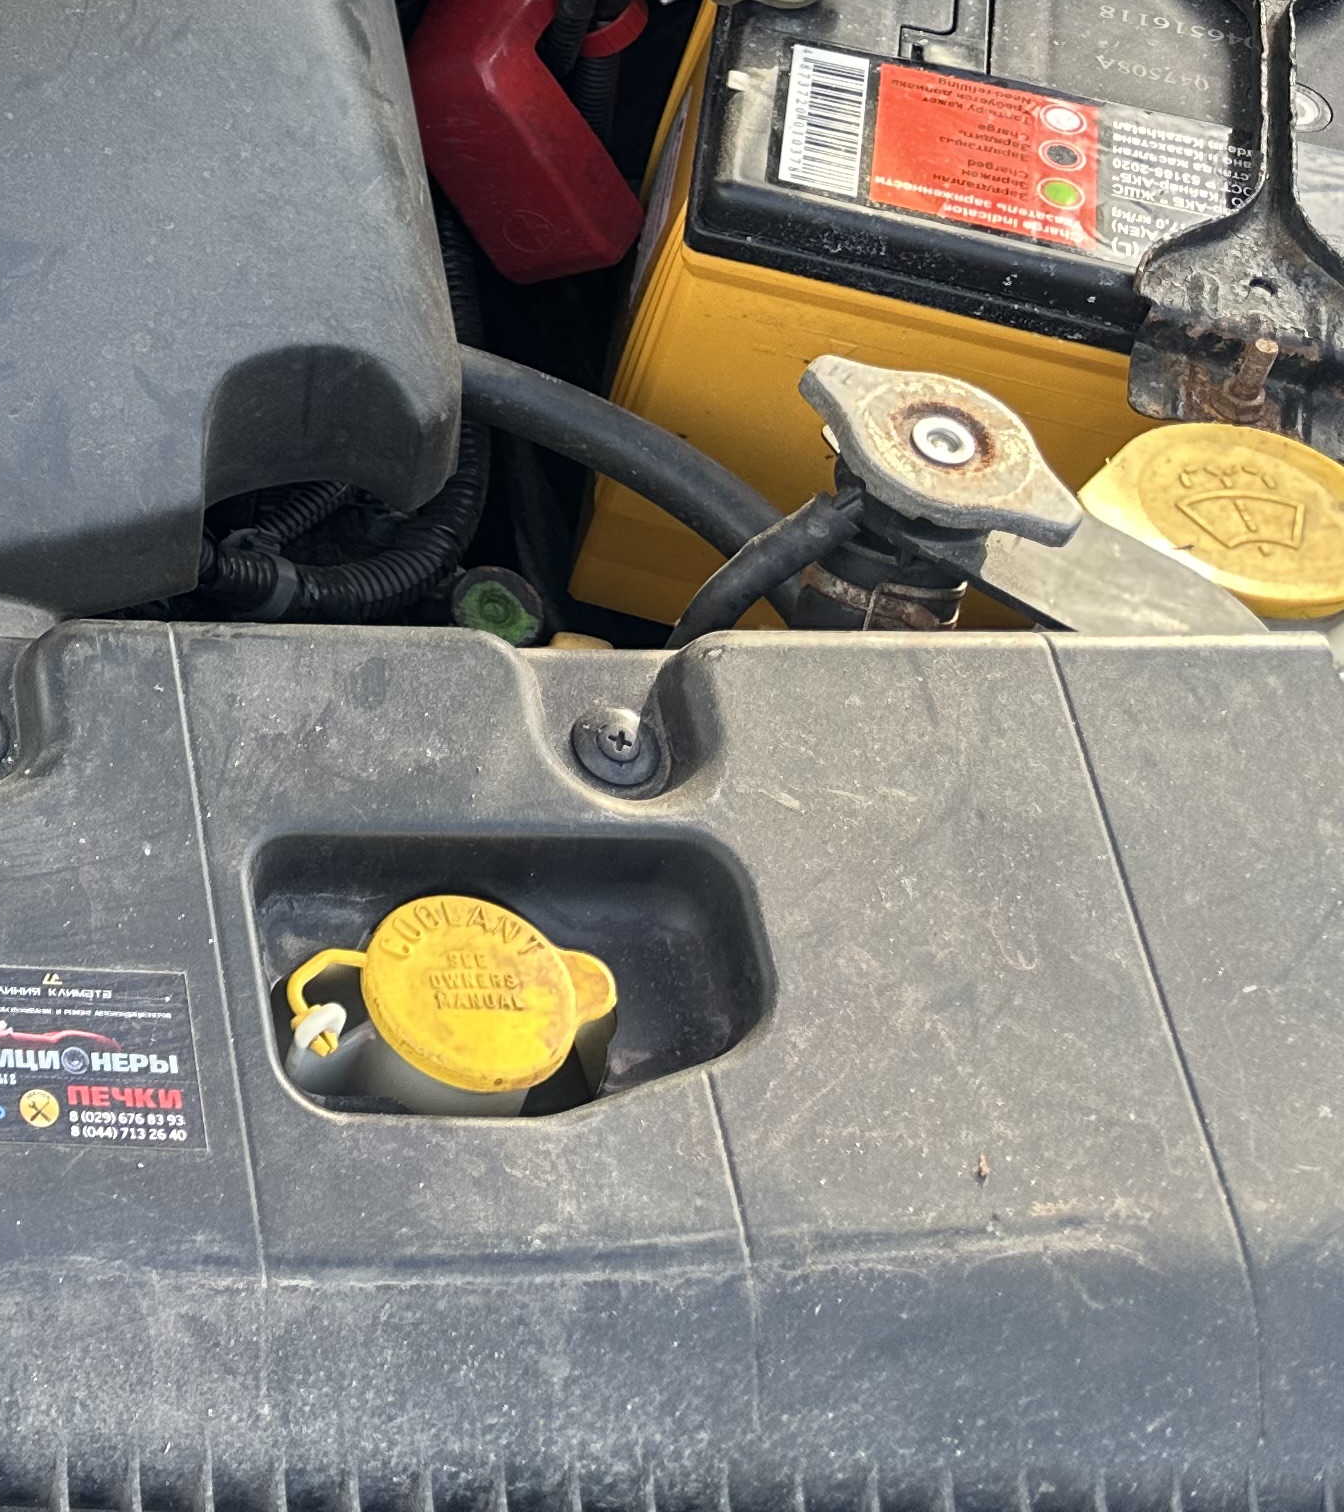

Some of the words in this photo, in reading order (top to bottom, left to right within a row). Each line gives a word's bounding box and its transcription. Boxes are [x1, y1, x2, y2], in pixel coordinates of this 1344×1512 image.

[995, 91, 1032, 105] Need
[977, 123, 1030, 141] Charge
[967, 158, 1029, 179] Charged
[874, 175, 993, 209] заряженности
[1022, 219, 1085, 244] Charge
[1111, 237, 1140, 258] (L)
[379, 900, 545, 961] COOLANT
[447, 951, 487, 969] SEE
[429, 970, 519, 989] OWNERS
[434, 991, 525, 1011] MANUAL
[67, 1084, 183, 1110] ПЕЧКИ
[68, 1110, 79, 1122] 8
[80, 1110, 116, 1125] (029)
[118, 1111, 143, 1125] 676
[147, 1112, 165, 1125] 83
[70, 1125, 80, 1138] 8
[81, 1125, 118, 1140] (044)
[120, 1126, 145, 1140] 713
[148, 1128, 167, 1140] 26
[168, 1128, 187, 1142] 40
